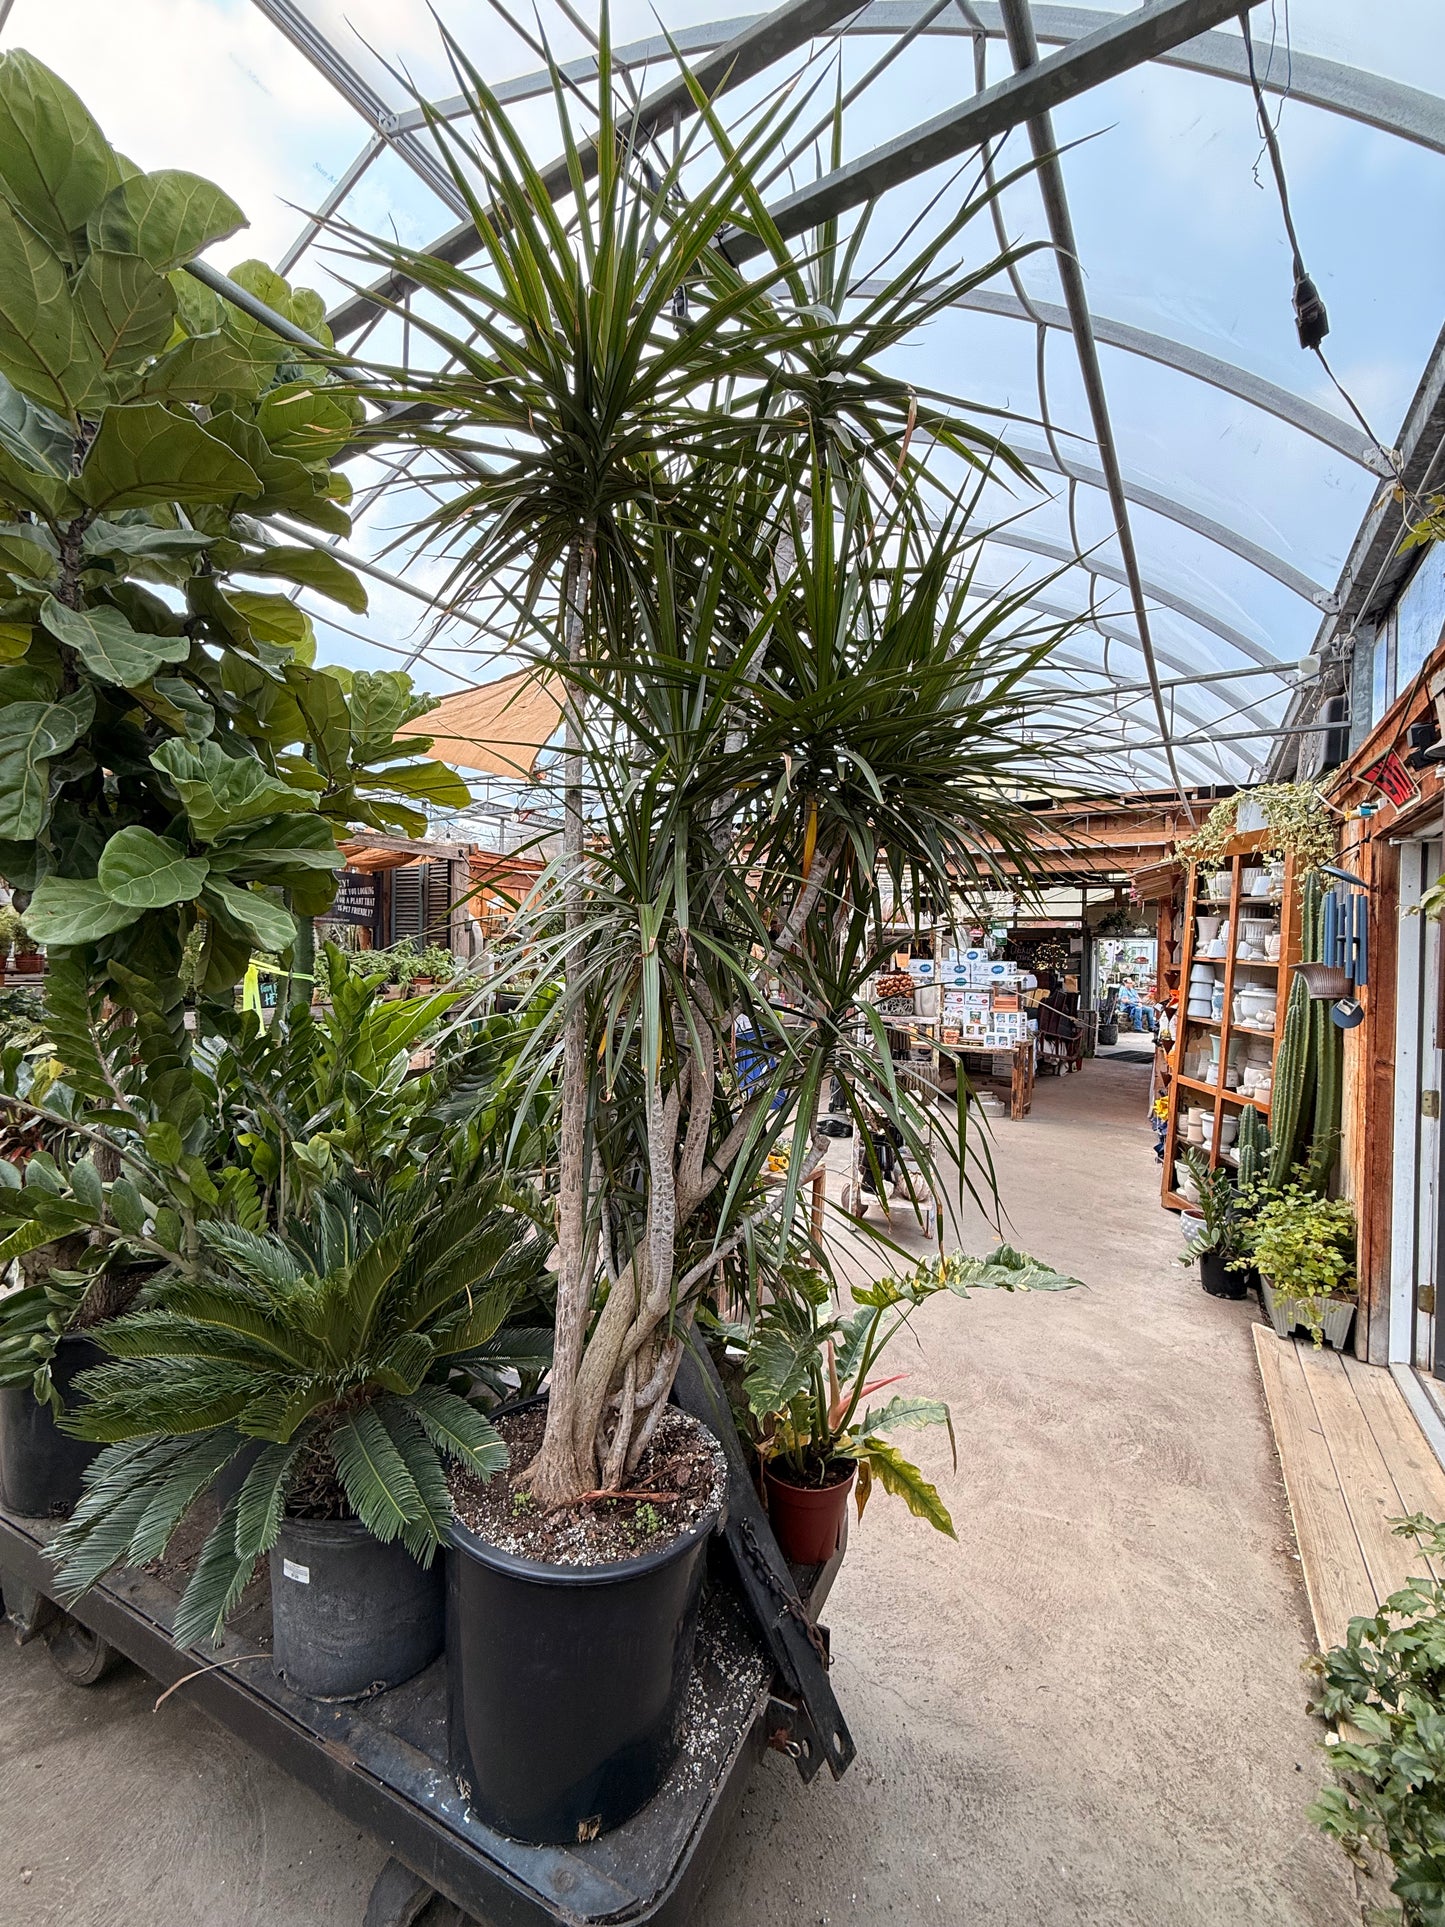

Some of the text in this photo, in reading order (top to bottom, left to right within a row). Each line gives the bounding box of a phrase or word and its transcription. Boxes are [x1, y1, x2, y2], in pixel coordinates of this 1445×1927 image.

[348, 887, 357, 895] YOU
[357, 886, 375, 895] LOOKING
[350, 897, 364, 905] PLANT
[364, 897, 375, 906] THAT
[342, 905, 351, 913] PET
[351, 907, 373, 917] FRIENDLY?
